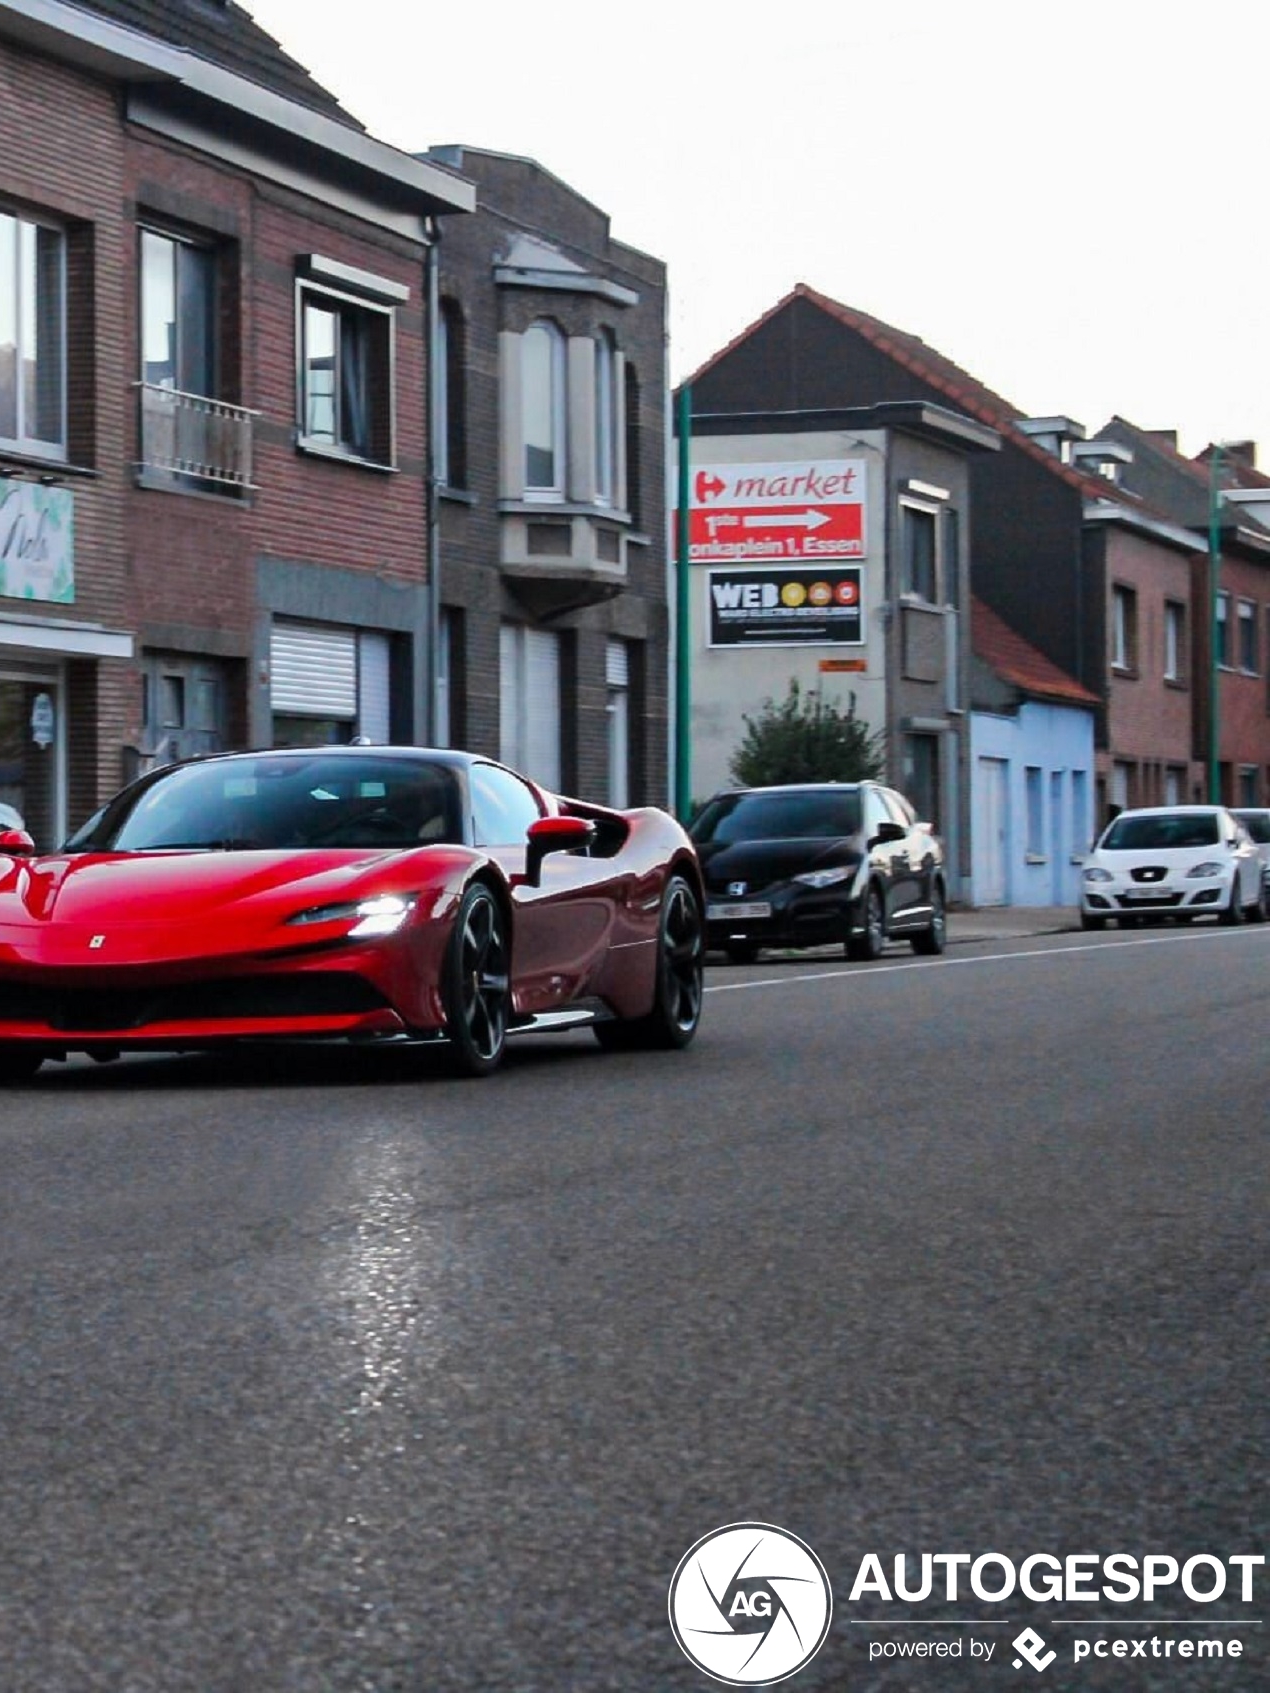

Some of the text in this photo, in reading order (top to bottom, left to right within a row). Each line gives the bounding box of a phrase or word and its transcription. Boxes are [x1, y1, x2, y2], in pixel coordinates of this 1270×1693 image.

[734, 467, 858, 499] market
[689, 537, 784, 559] onkaplein
[803, 536, 861, 554] Essen
[712, 582, 779, 608] WEB
